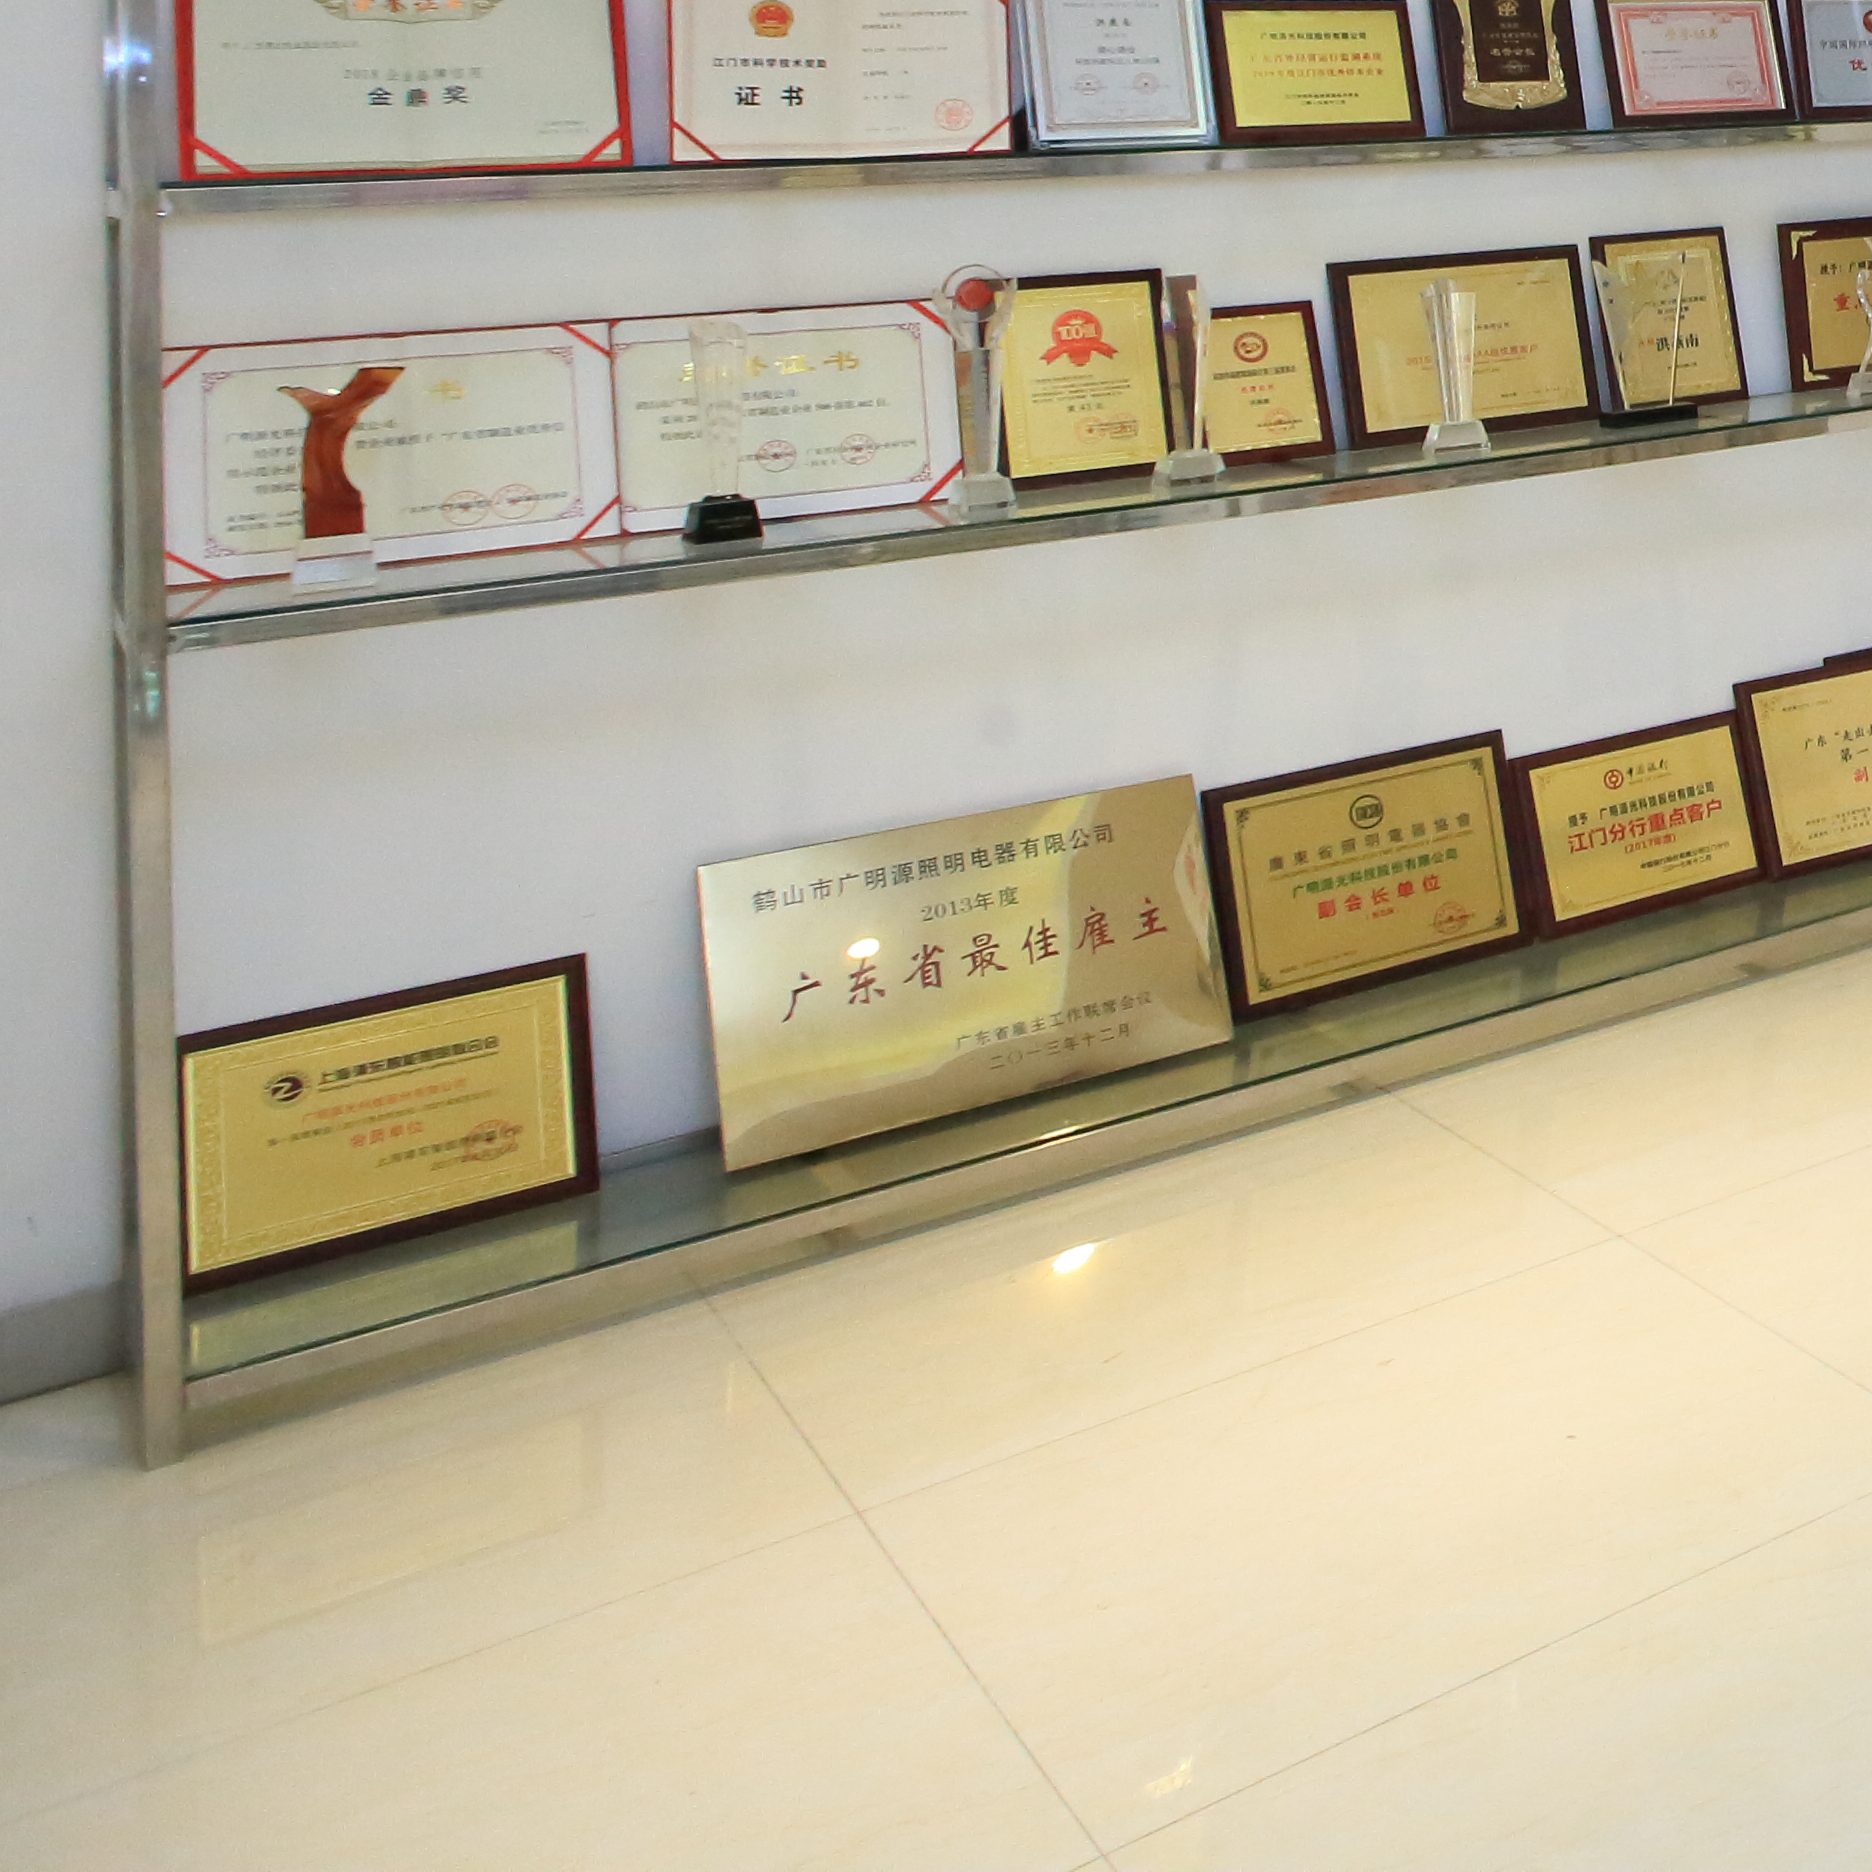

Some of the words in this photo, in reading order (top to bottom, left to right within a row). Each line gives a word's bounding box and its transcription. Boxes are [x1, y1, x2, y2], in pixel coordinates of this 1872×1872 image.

[735, 85, 804, 108] 证书
[1600, 781, 1715, 820] 广明源光科技股份有限公司
[1568, 799, 1722, 854] 江门分行重点客户
[752, 822, 1114, 913] 鹤山市广明源照明电器有限公司
[1292, 847, 1457, 898] 广明源光科技股份有限公司
[920, 886, 1020, 922] 2013年度
[1317, 874, 1440, 920] 副会长单位
[781, 896, 1168, 1023] 广东省最佳雇主
[955, 990, 1153, 1051] 广东省雇主工作联席会议
